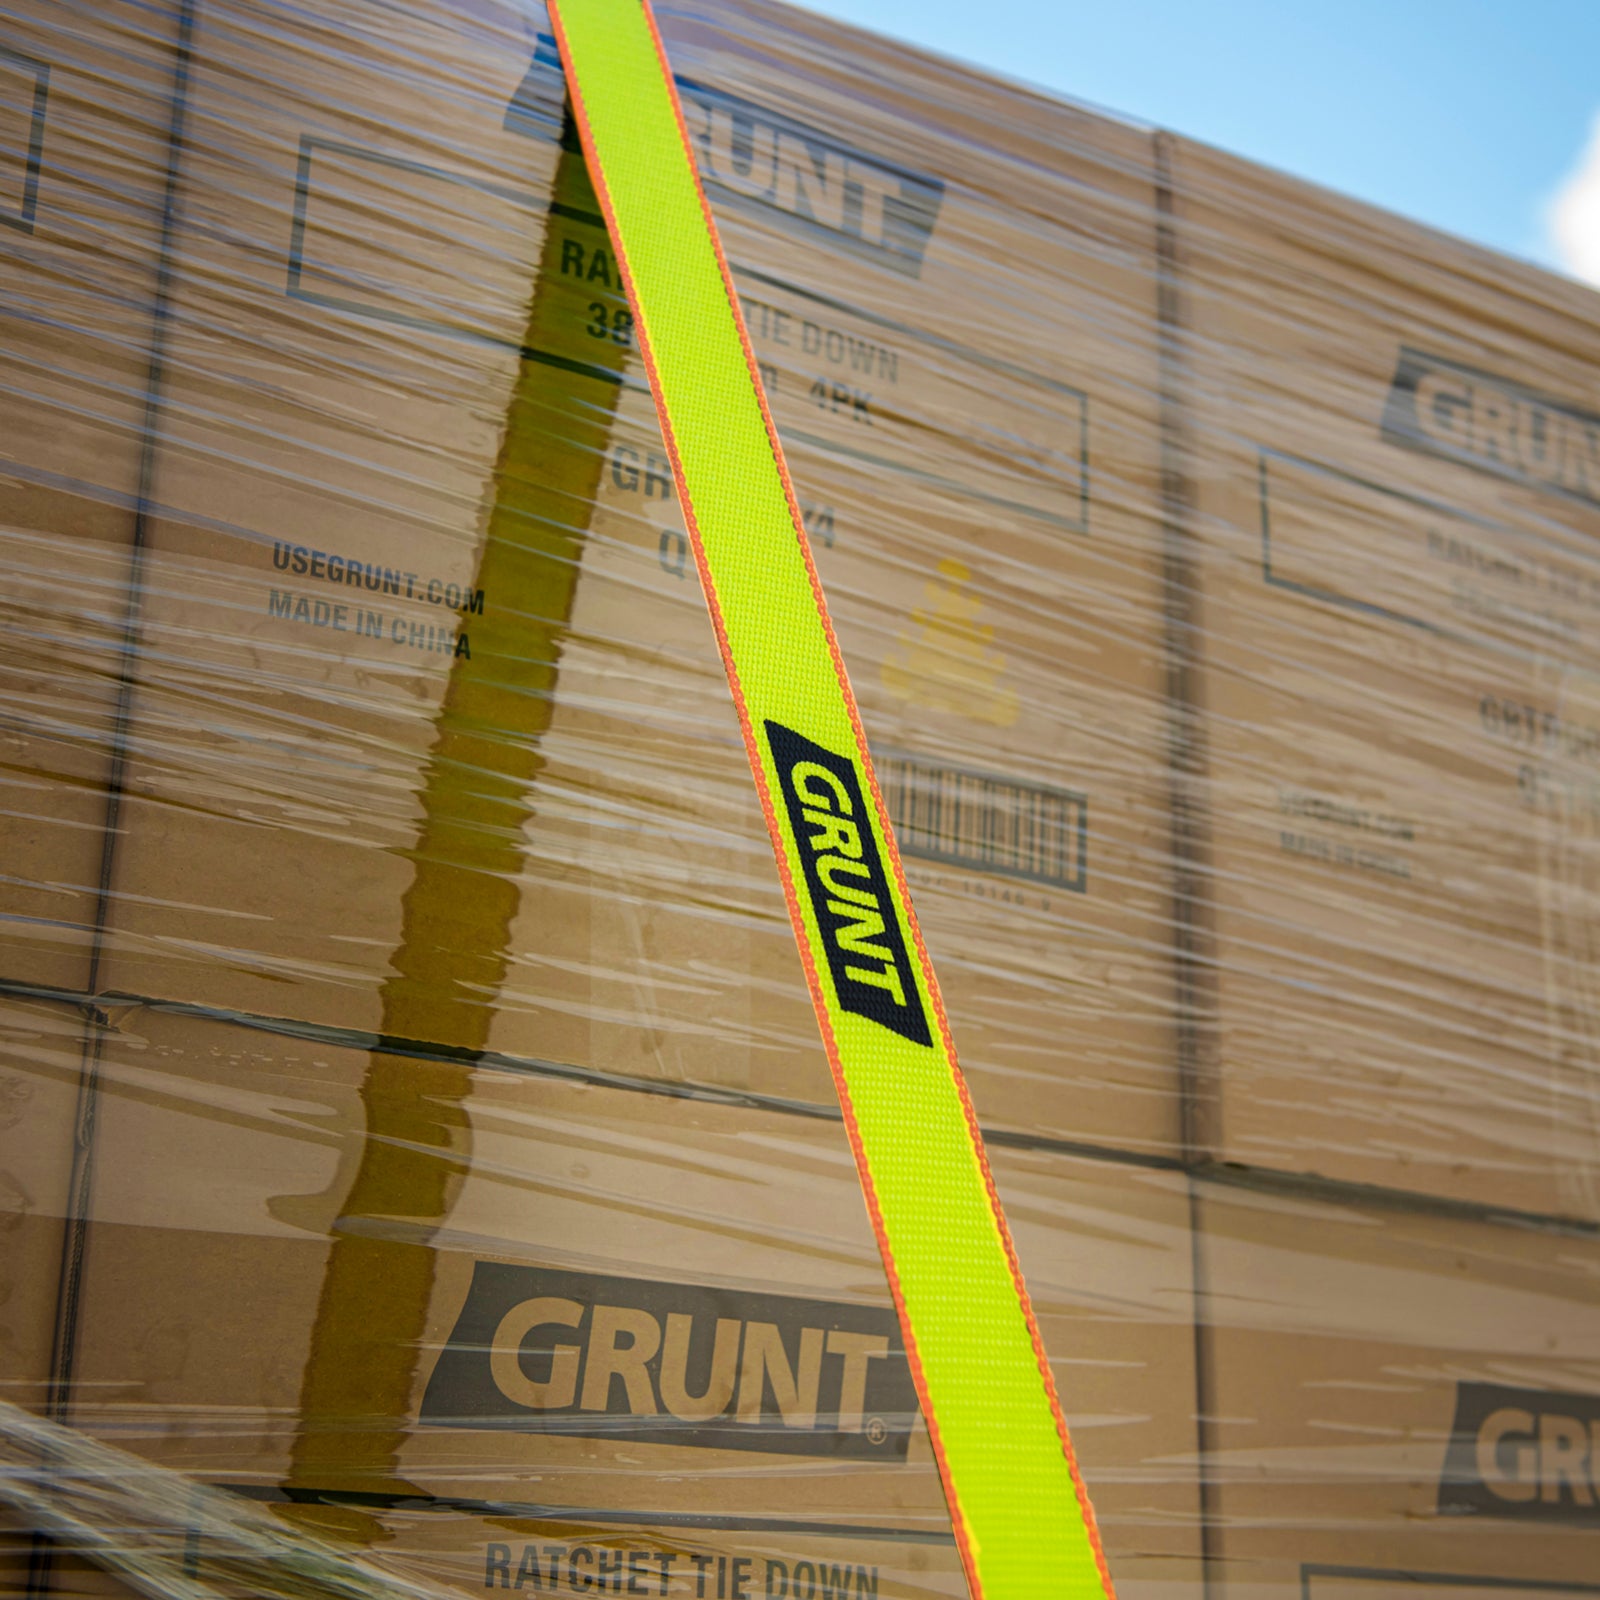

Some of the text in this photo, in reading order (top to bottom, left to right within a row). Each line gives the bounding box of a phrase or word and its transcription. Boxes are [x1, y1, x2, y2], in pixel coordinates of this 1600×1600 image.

[561, 239, 626, 291] RA
[801, 319, 899, 386] DOWN
[809, 376, 873, 426] 4PK
[273, 541, 486, 616] USEGRUNT.COM
[268, 589, 472, 661] MADE IN CHINA
[791, 760, 907, 1008] GRUNT
[489, 1296, 889, 1434] GRUNT
[1475, 1408, 1600, 1507] GR
[485, 1542, 879, 1600] RATCHET TIE DOWN
